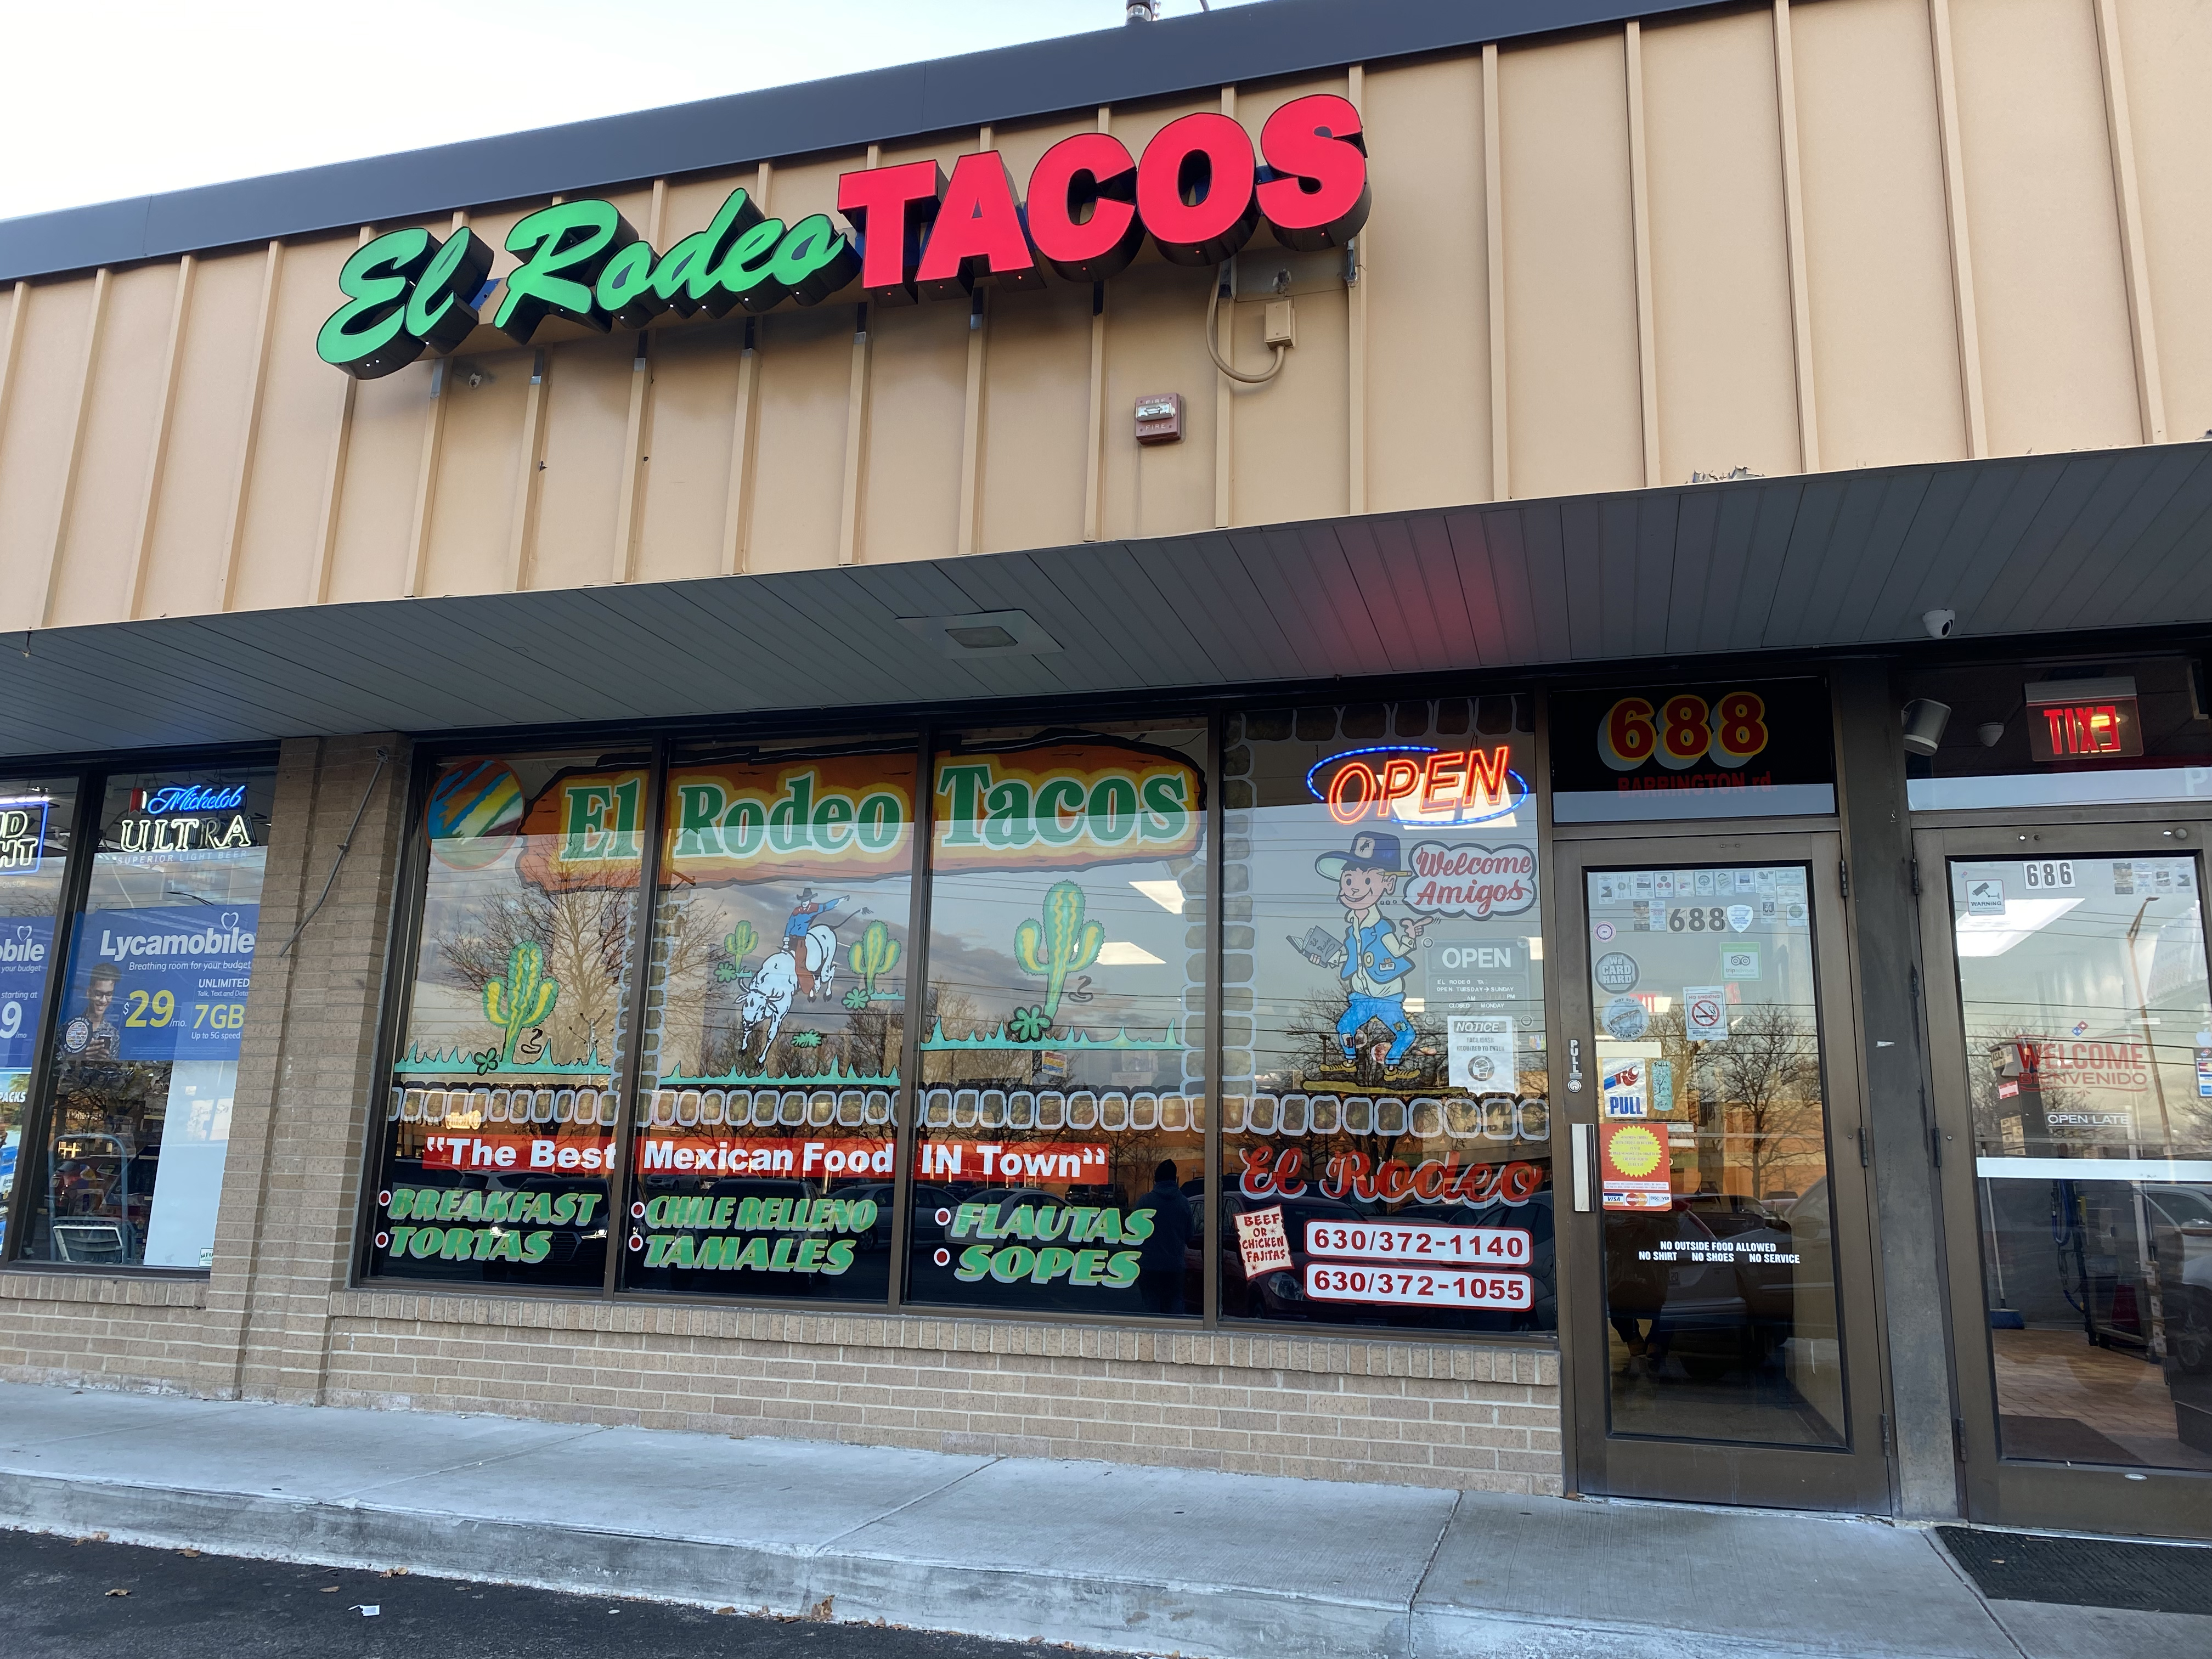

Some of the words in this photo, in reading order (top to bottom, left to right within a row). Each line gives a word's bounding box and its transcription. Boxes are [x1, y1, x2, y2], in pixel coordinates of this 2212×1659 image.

[317, 226, 486, 373] El
[493, 188, 850, 337] Rodeo
[837, 93, 1372, 302] TACOS
[1598, 691, 1768, 770] 688
[1329, 745, 1509, 824] OPEN
[1618, 772, 1745, 798] BARRINGTON
[148, 785, 246, 814] Michelob
[560, 777, 642, 862] El
[673, 771, 902, 859] Rodeo
[936, 763, 1188, 850] Tacos
[121, 815, 251, 853] ULTRA
[117, 855, 173, 865] SUPERIOR
[180, 852, 211, 861] LIGHT
[219, 850, 247, 859] BEER
[1416, 847, 1532, 877] Welcome
[2027, 862, 2072, 887] 686
[1414, 879, 1532, 915] Amigos
[1669, 907, 1726, 932] 688
[100, 927, 255, 961] Lycamobile
[1, 966, 16, 974] your
[18, 964, 41, 974] budget
[129, 962, 166, 972] Breathing
[191, 961, 202, 969] for
[203, 963, 221, 972] your
[223, 961, 251, 971] budget
[1442, 947, 1511, 968] OPEN
[1601, 964, 1632, 975] CARD
[1609, 956, 1623, 965] We
[199, 978, 250, 988] UNLIMITED
[1602, 974, 1633, 984] HARD
[1, 991, 29, 1000] starting
[191, 1032, 200, 1040] Up
[221, 1031, 241, 1040] speed
[1457, 1022, 1500, 1032] NOTICE
[1570, 1039, 1579, 1073] PULL
[2017, 1043, 2146, 1070] WELCOME
[2018, 1072, 2147, 1085] BIENVENIDO
[1609, 1097, 1643, 1115] PULL
[2047, 1115, 2088, 1124] OPEN
[2092, 1115, 2130, 1125] LATE
[530, 1139, 616, 1169] Best
[644, 1140, 793, 1171] Mexican
[803, 1142, 894, 1173] Food
[922, 1144, 962, 1174] IN
[1239, 1145, 1308, 1200] El
[1320, 1150, 1543, 1210] Rodeo
[387, 1188, 602, 1226] BREAKFAST
[645, 1195, 736, 1230] CHILE
[734, 1197, 878, 1233] RELLENO
[1244, 1213, 1279, 1227] BEEF
[950, 1203, 1157, 1245] FLAUTAS
[1253, 1227, 1267, 1237] OR
[389, 1226, 552, 1263] TORTAS
[644, 1234, 857, 1276] TAMALES
[1314, 1228, 1523, 1258] 630/372-1140
[1660, 1241, 1672, 1250] NO
[1674, 1241, 1709, 1251] OUTSIDE
[1712, 1242, 1734, 1251] FOOD
[1736, 1243, 1776, 1252] ALLOWED
[953, 1245, 1142, 1288] SOPES
[1639, 1251, 1651, 1260] NO
[1653, 1251, 1678, 1261] SHIRT
[1691, 1251, 1704, 1261] NO
[1706, 1252, 1735, 1262] SHOES
[1749, 1253, 1762, 1262] NO
[1764, 1253, 1801, 1264] SERVICE
[1314, 1270, 1524, 1301] 630/372-1055
